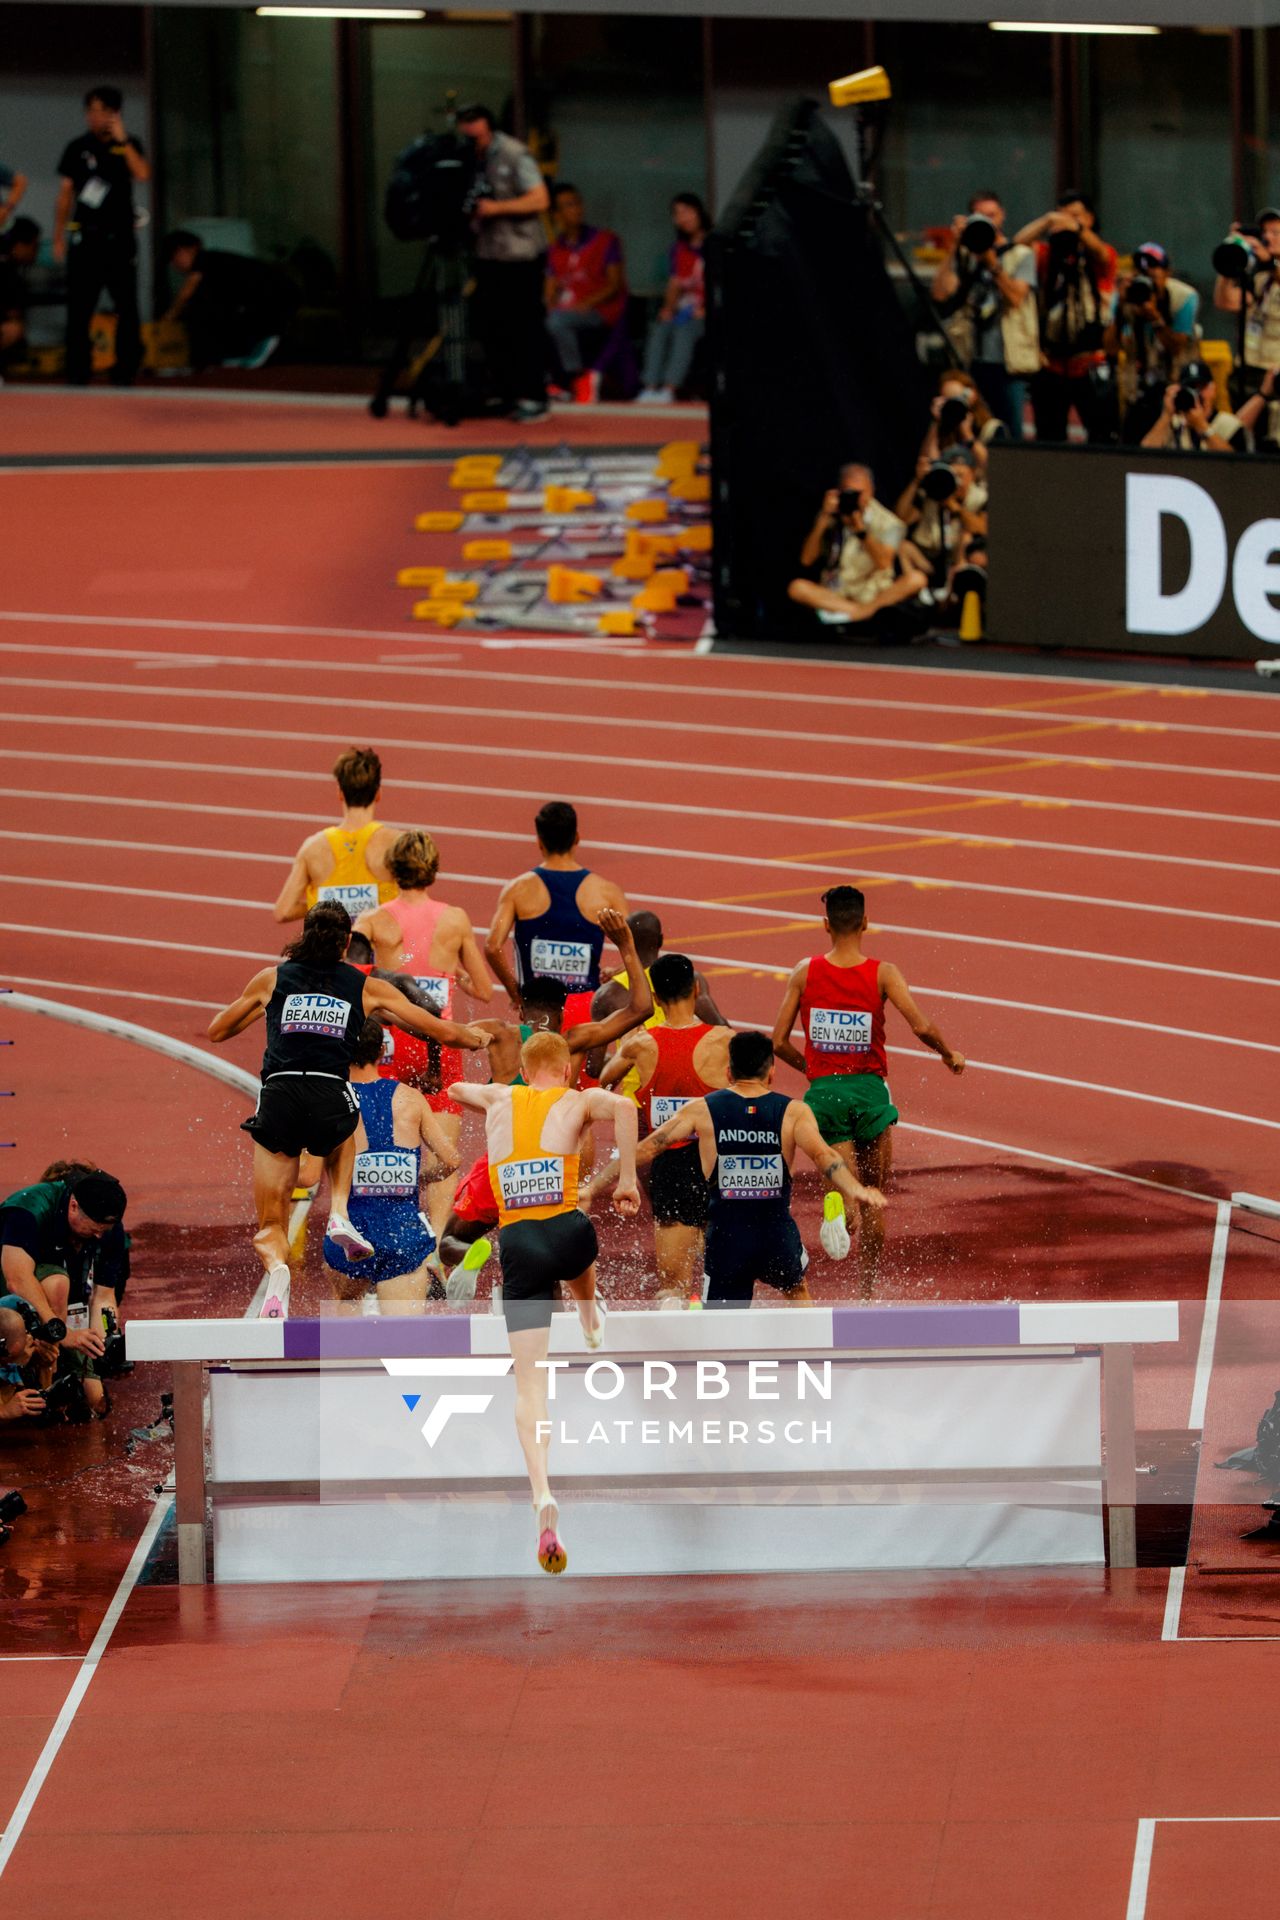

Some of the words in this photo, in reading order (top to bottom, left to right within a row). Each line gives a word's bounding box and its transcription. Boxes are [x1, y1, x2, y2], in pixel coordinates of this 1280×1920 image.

[335, 886, 372, 899] TDK
[547, 943, 585, 958] TDK
[533, 957, 587, 972] GILAVERT
[416, 979, 442, 991] DK
[304, 995, 345, 1010] TDK
[285, 1010, 345, 1025] BEAMISH
[826, 1011, 866, 1027] TDK
[812, 1026, 830, 1040] BEN
[833, 1028, 868, 1042] YAZIDE
[370, 1154, 411, 1167] TDK
[514, 1160, 559, 1176] TDK
[736, 1156, 777, 1170] TDK
[357, 1170, 413, 1184] ROOKS
[721, 1172, 780, 1188] CARABAÑA
[503, 1176, 562, 1197] RUPPERT
